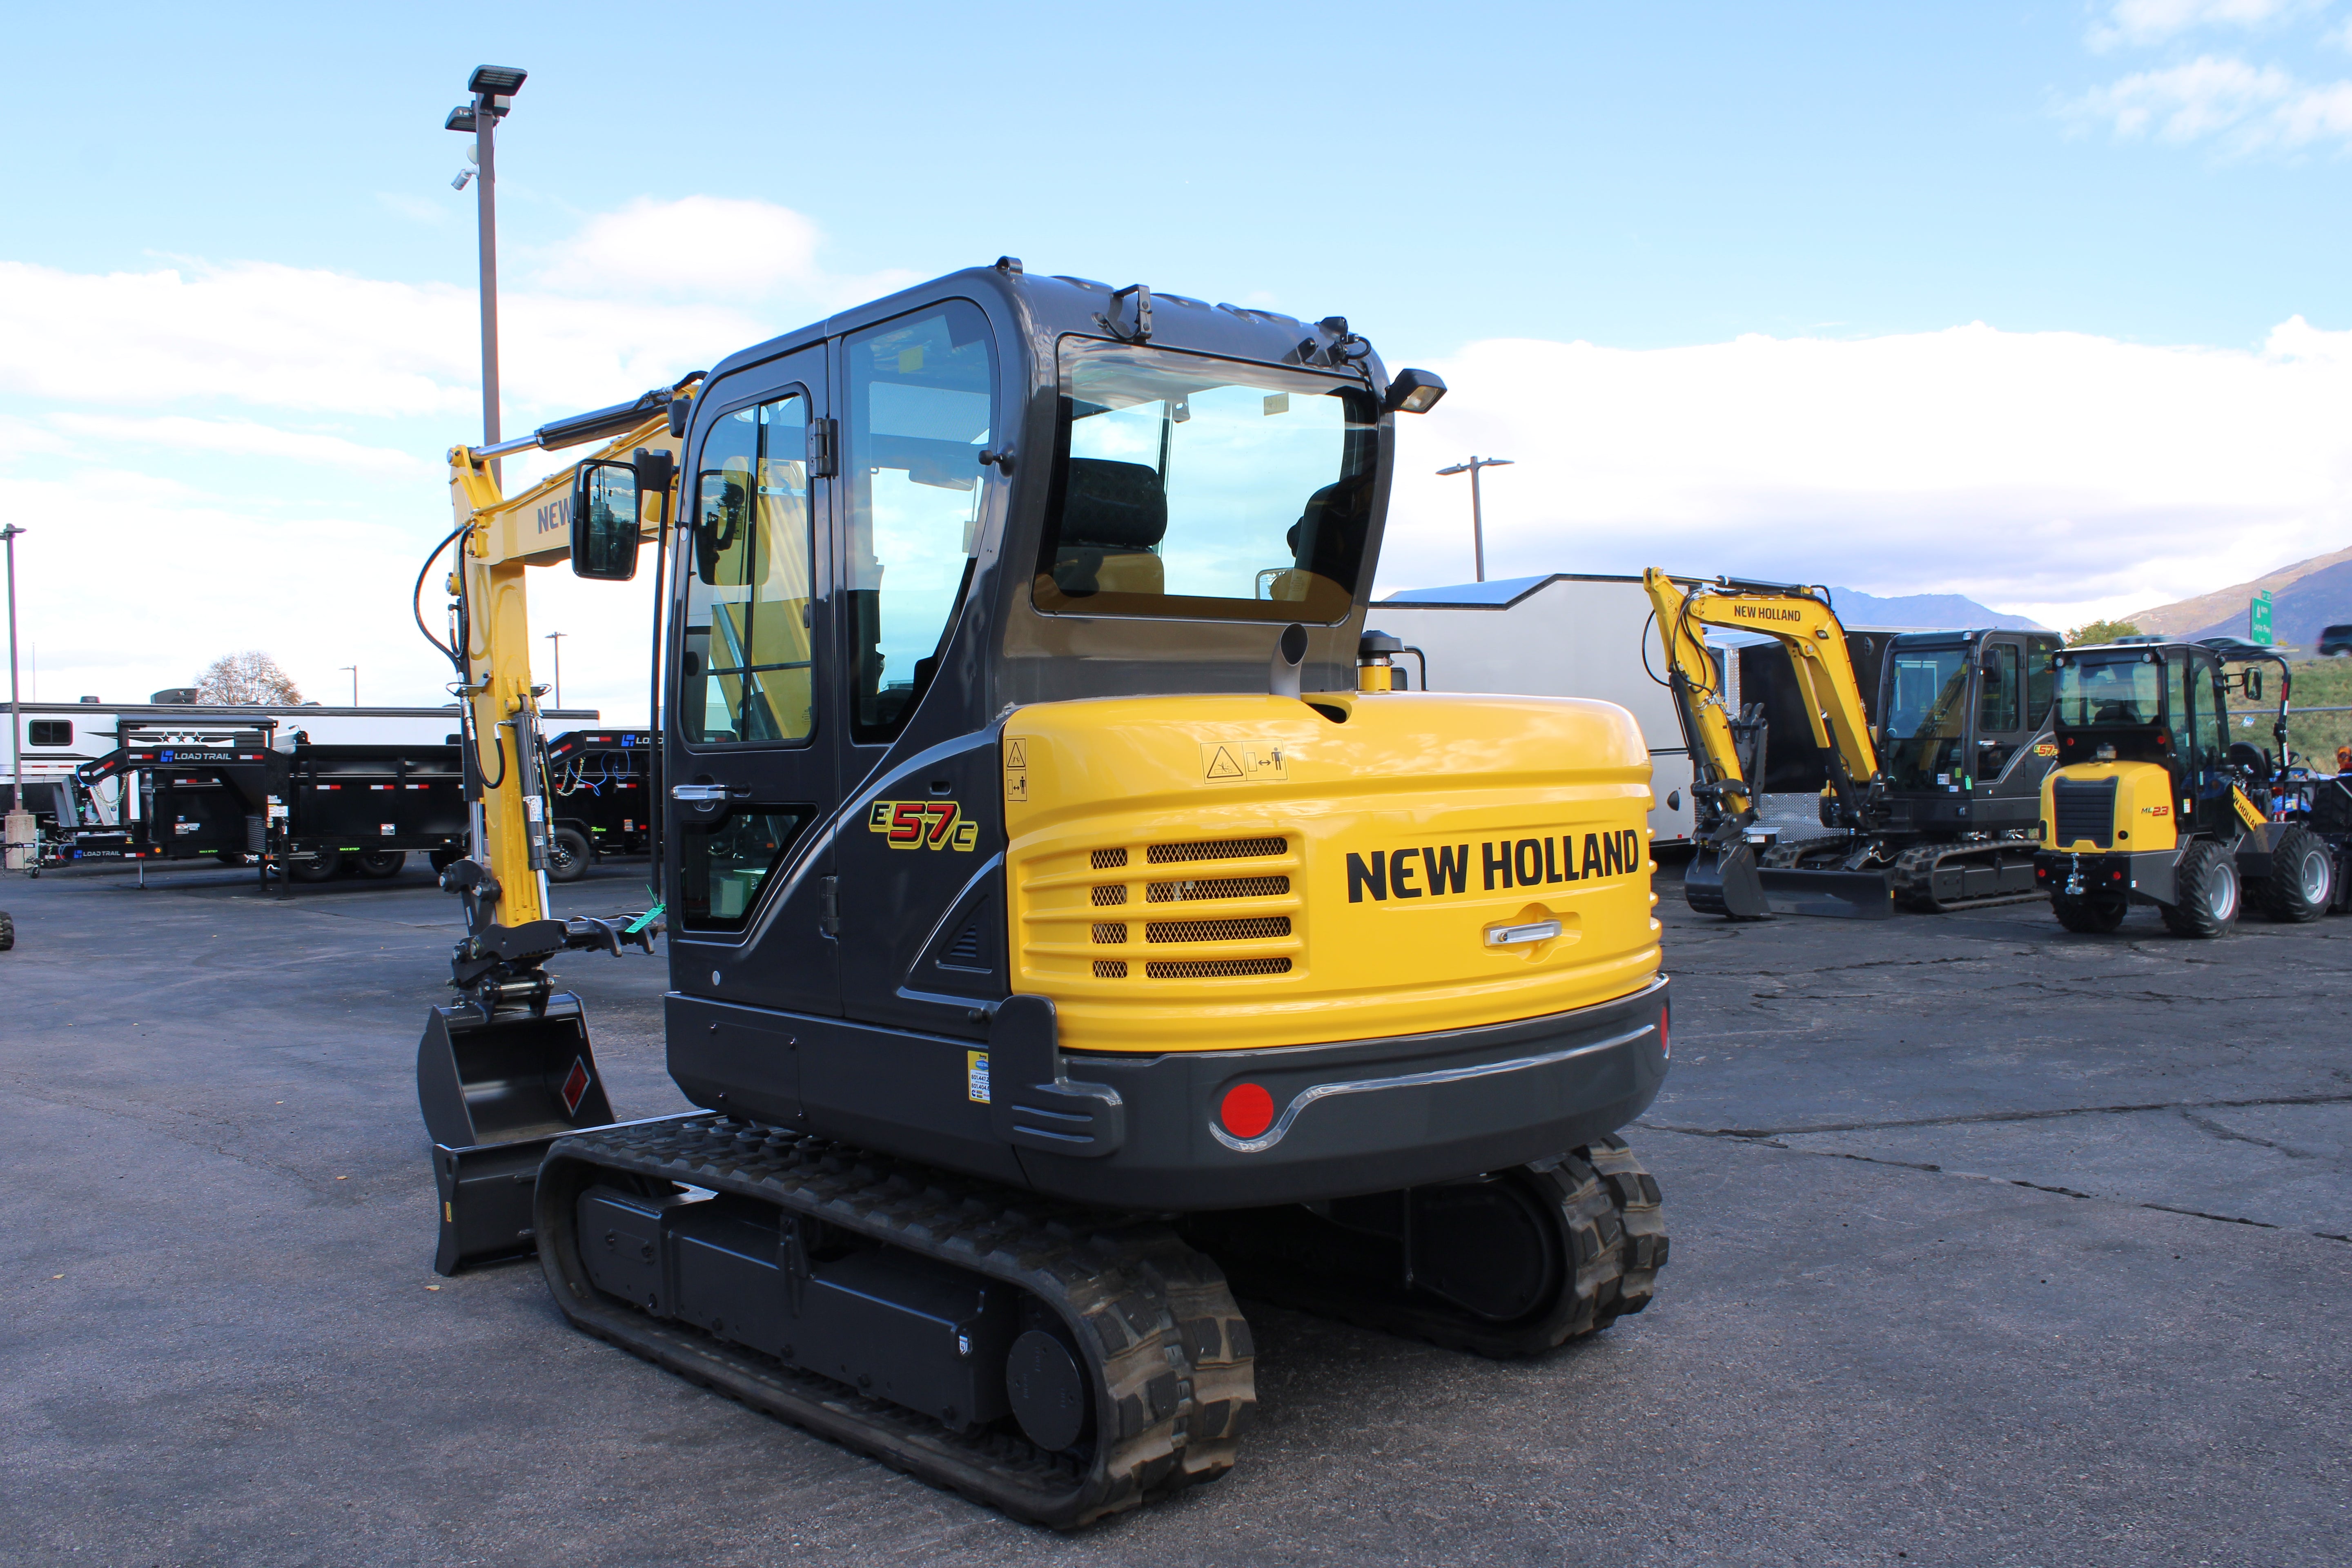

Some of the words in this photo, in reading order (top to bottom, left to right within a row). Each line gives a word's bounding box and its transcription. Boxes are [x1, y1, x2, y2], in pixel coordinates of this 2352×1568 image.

[537, 497, 572, 535] NEW
[1735, 605, 1756, 618] NEW
[1759, 607, 1801, 621] HOLLAND
[2034, 744, 2058, 757] E57C
[2140, 806, 2169, 816] ML23
[869, 801, 978, 851] E57C
[1346, 844, 1469, 903] NEW
[1481, 829, 1639, 891] HOLLAND
